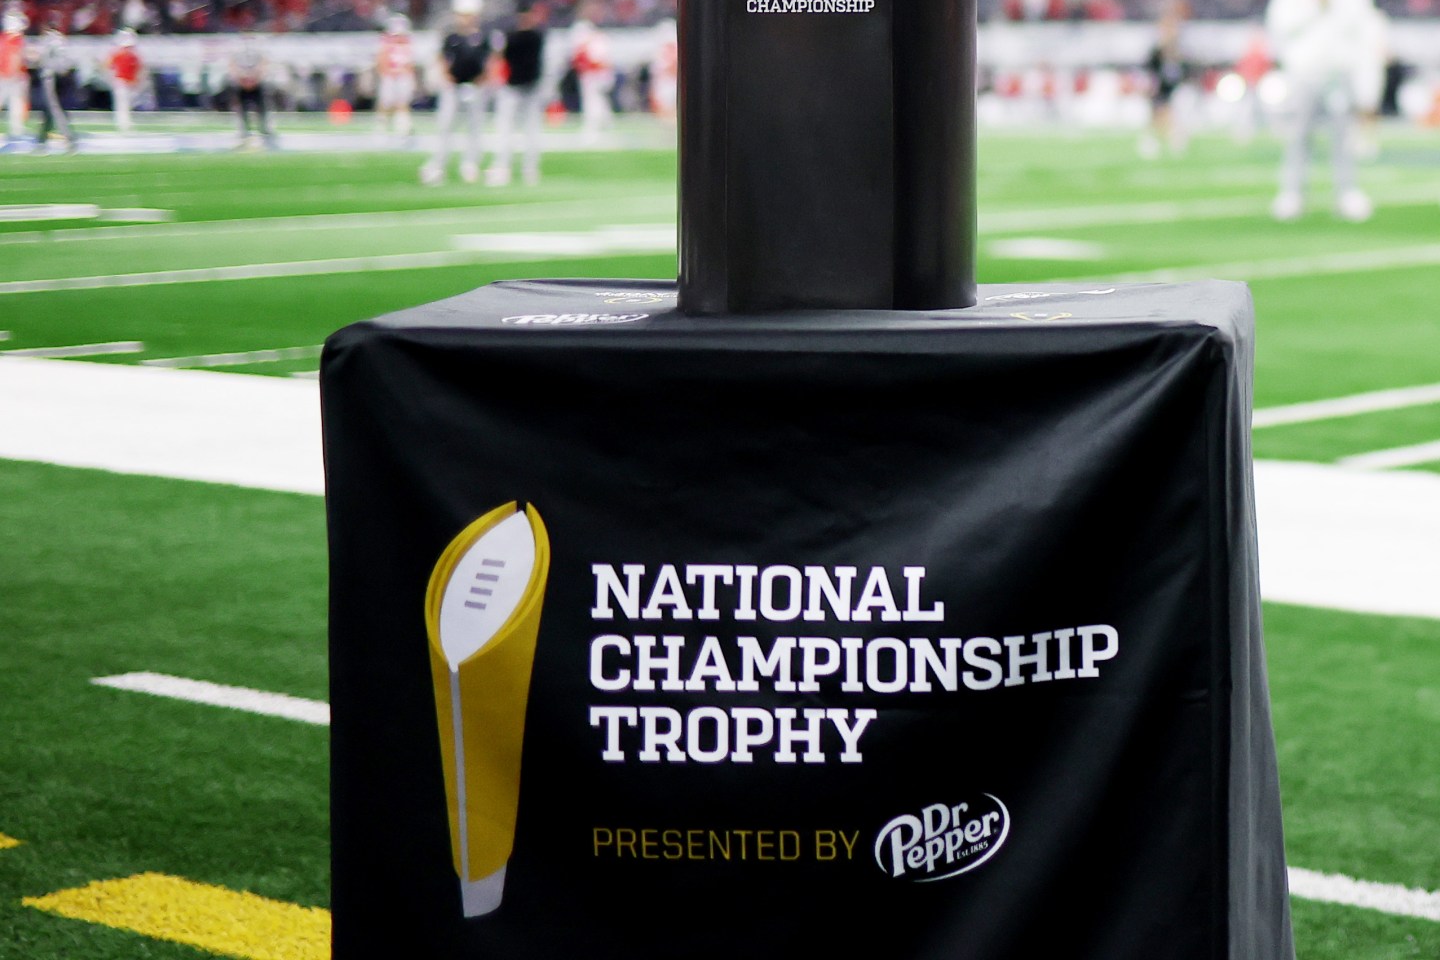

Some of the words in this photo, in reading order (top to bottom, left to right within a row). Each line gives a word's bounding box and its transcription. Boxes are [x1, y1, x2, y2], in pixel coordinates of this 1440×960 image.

[590, 563, 945, 622] NATIONAL
[589, 624, 1119, 693] CHAMPIONSHIP
[589, 705, 878, 763] TROPHY
[594, 830, 800, 860] PRESENTED
[815, 830, 860, 860] BY
[875, 811, 1000, 877] Pepper
[921, 801, 969, 841] Dr
